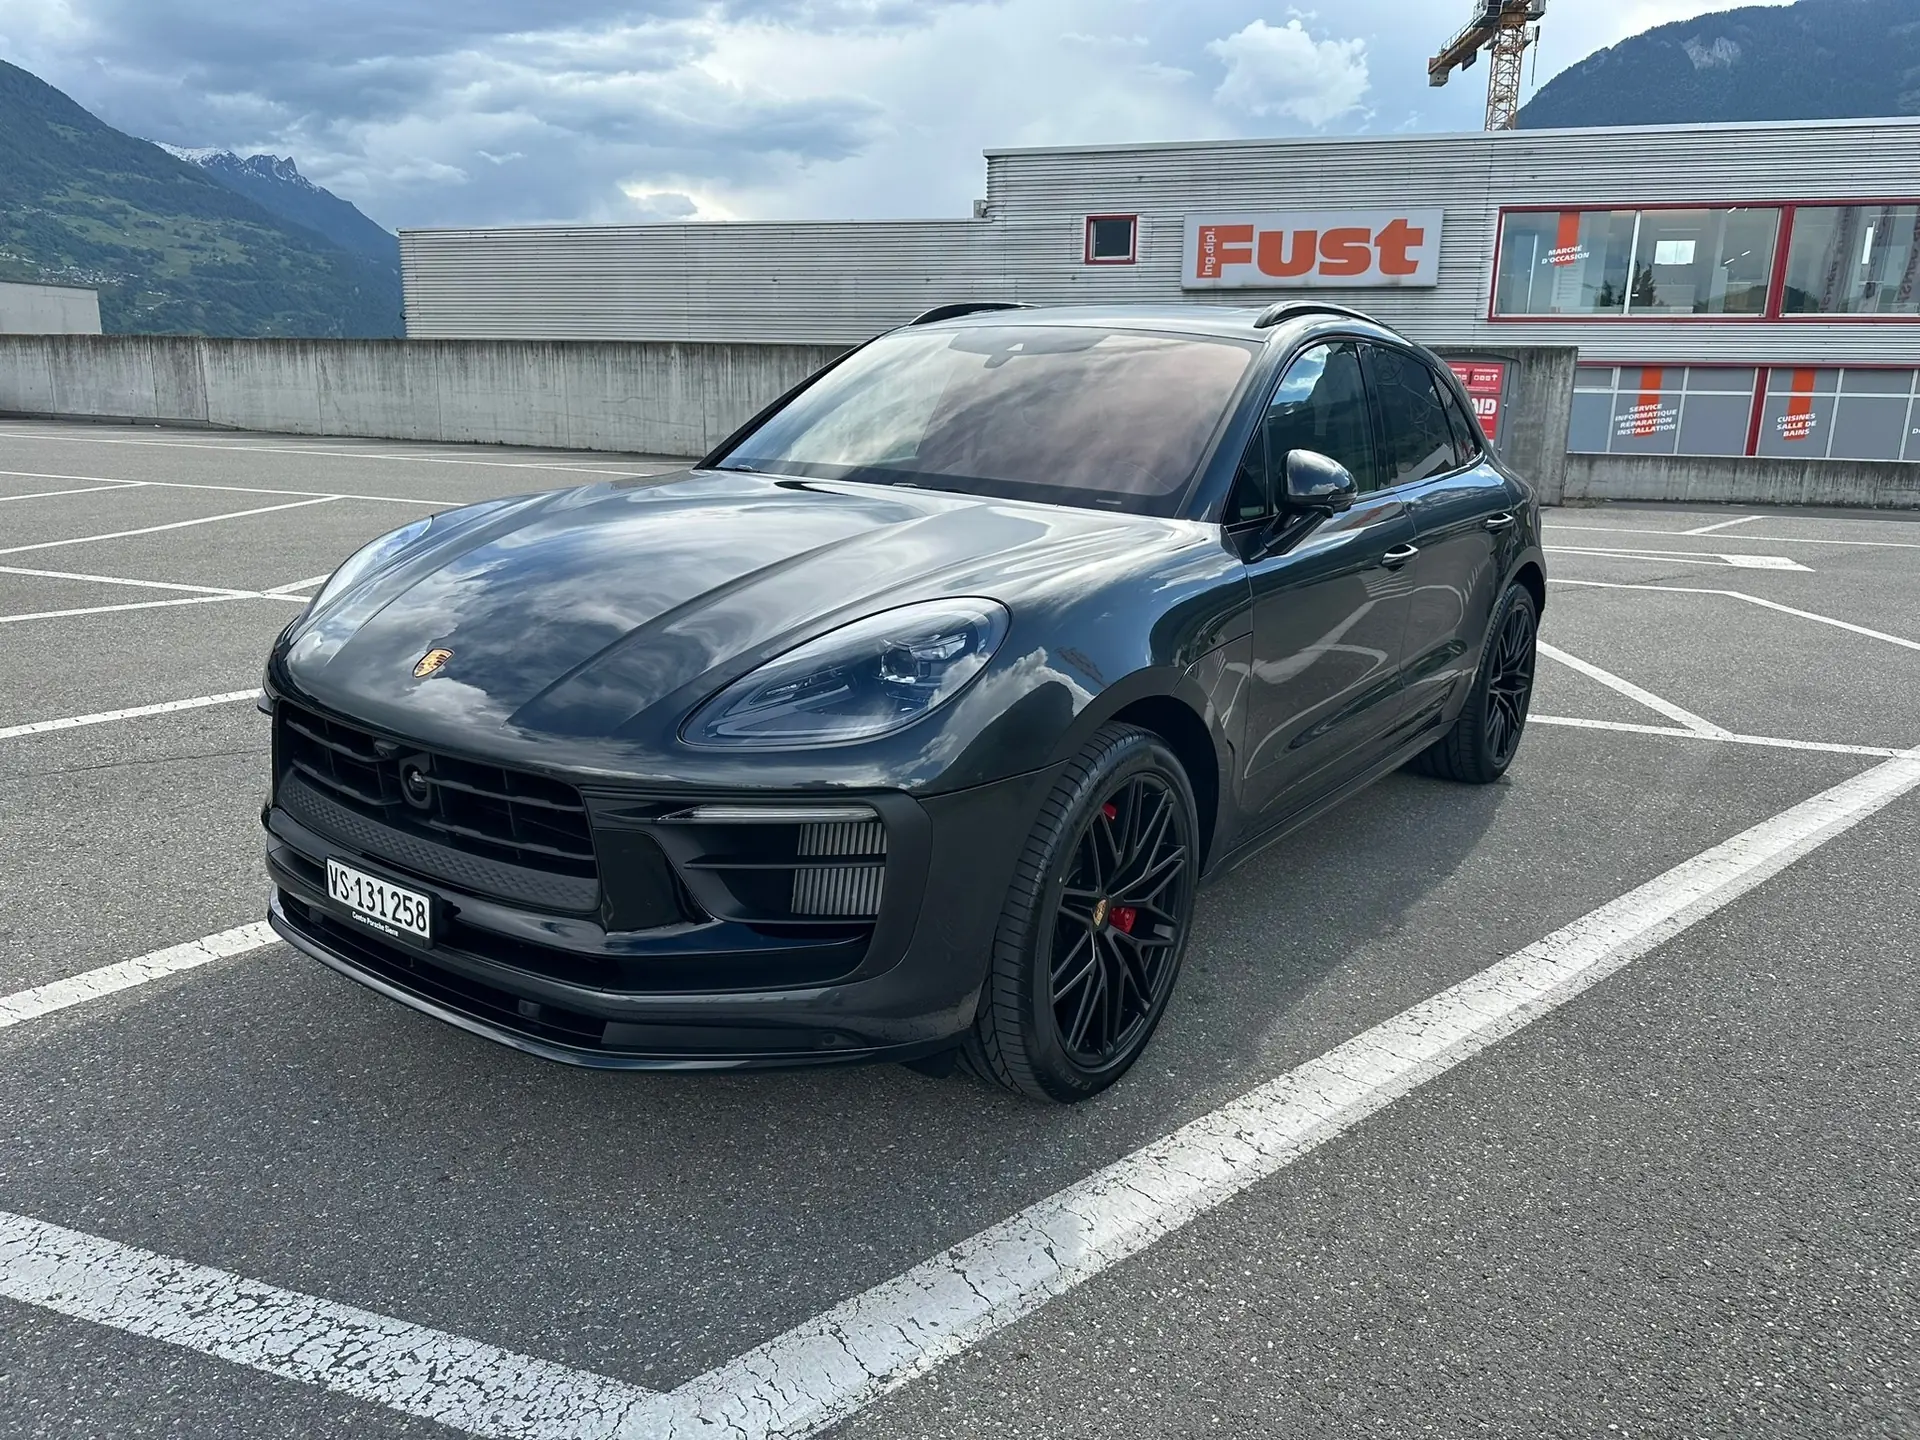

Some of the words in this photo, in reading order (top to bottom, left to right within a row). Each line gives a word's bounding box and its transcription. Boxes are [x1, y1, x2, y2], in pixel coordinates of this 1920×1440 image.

[1196, 219, 1424, 278] Fust
[1548, 244, 1582, 256] MARCHÉ
[1541, 252, 1590, 264] D'OCCASION
[1629, 404, 1662, 413] SERVICE
[1615, 409, 1677, 421] INFORMATIQUE
[1777, 413, 1816, 423] CUISINES
[1617, 424, 1676, 436] INSTALLATION
[1776, 422, 1803, 430] SALLE
[1805, 420, 1817, 428] DE
[1783, 429, 1810, 437] BAINS
